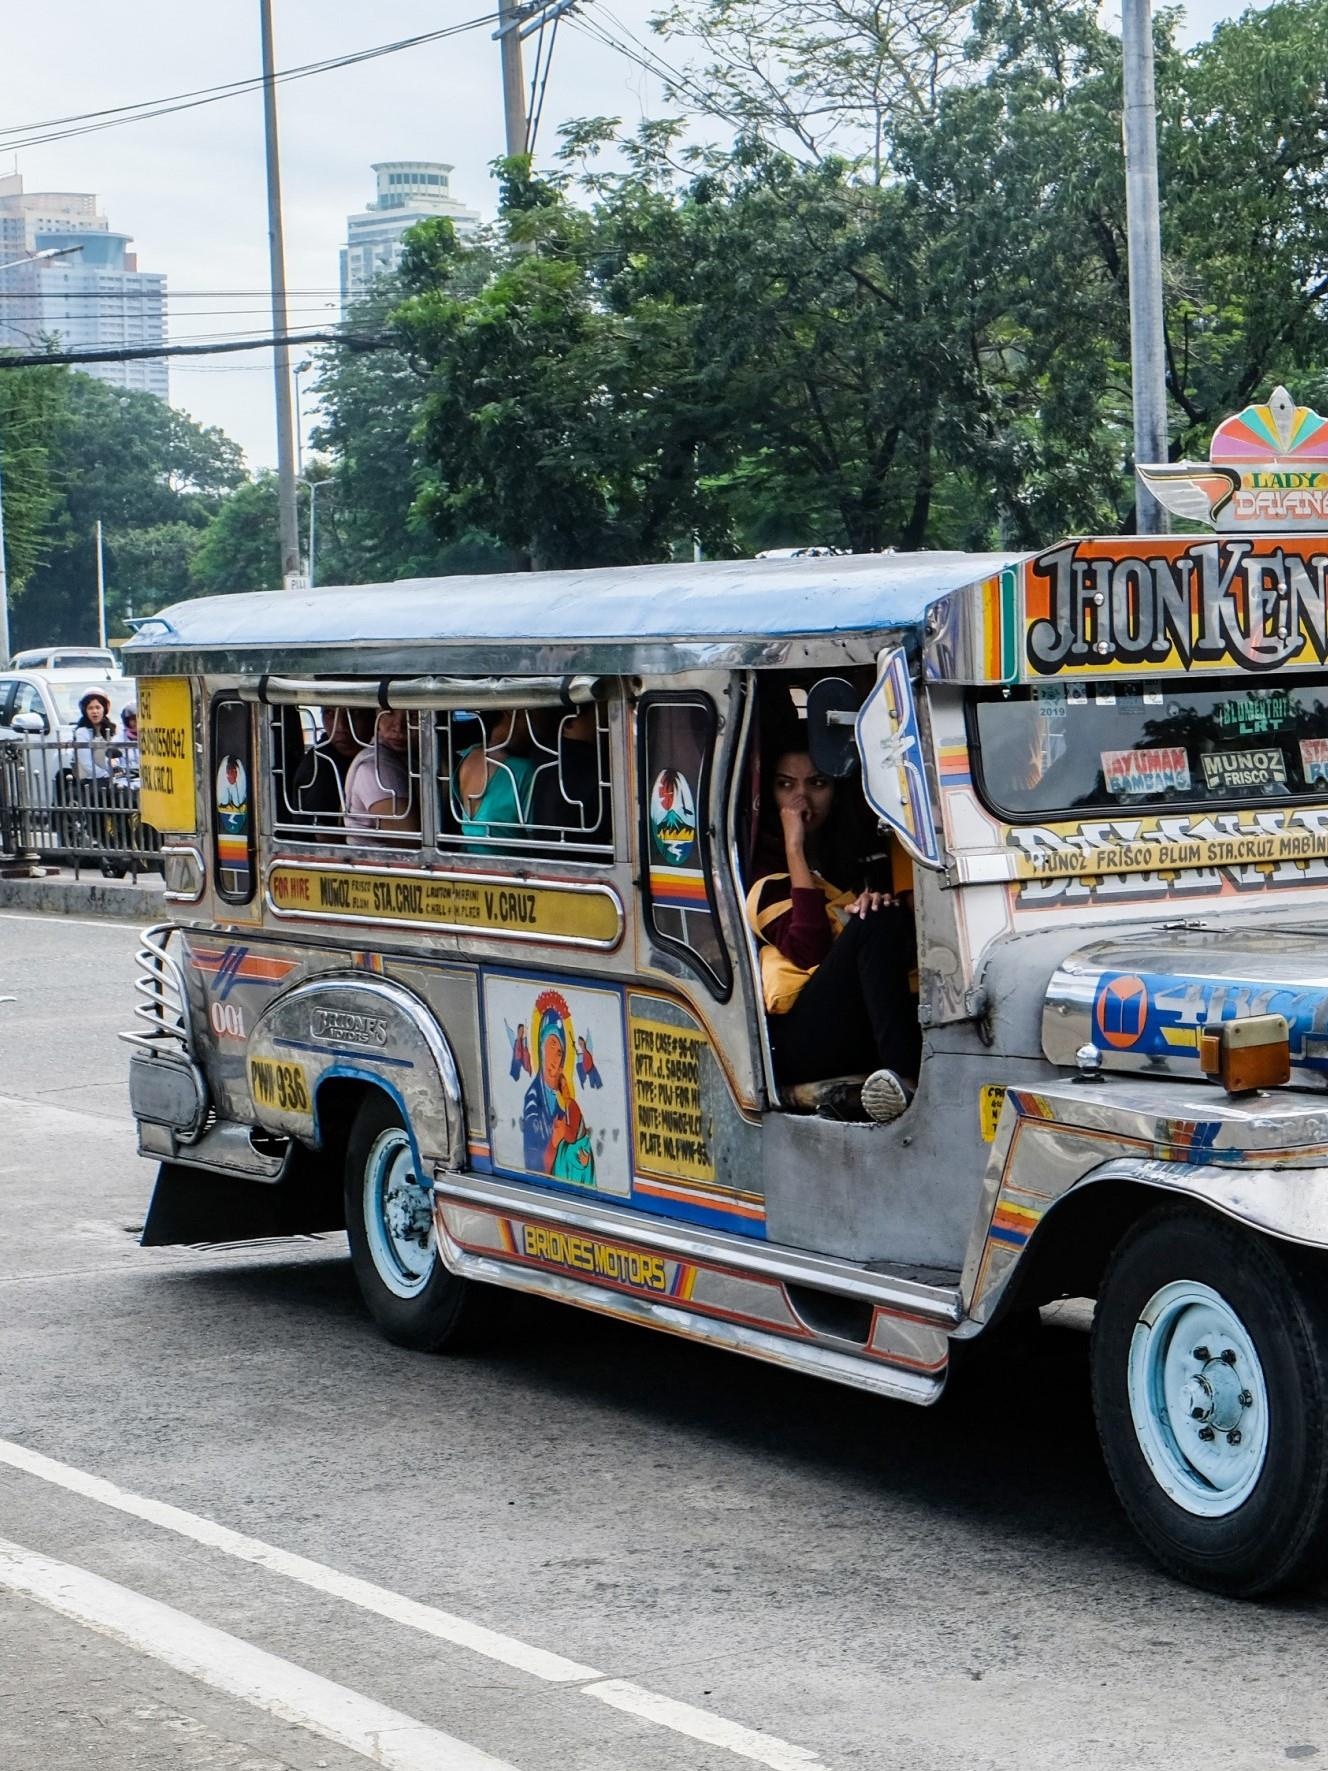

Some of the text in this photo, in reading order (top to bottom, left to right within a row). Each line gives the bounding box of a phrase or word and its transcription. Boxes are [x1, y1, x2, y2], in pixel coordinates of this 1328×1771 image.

[1251, 472, 1322, 489] LADY
[1040, 707, 1065, 717] 2019
[1239, 719, 1284, 735] LRT
[1223, 769, 1269, 786] FRISCO
[1097, 847, 1152, 870] FRISCO
[1158, 844, 1201, 865] BLUM
[1207, 838, 1275, 861] STA.CRUZ
[273, 876, 310, 901] FOR HIRE
[372, 881, 424, 914] STA.CRUZ
[484, 890, 537, 924] V.CRUZ
[211, 1002, 247, 1038] 001
[275, 1064, 308, 1109] 936
